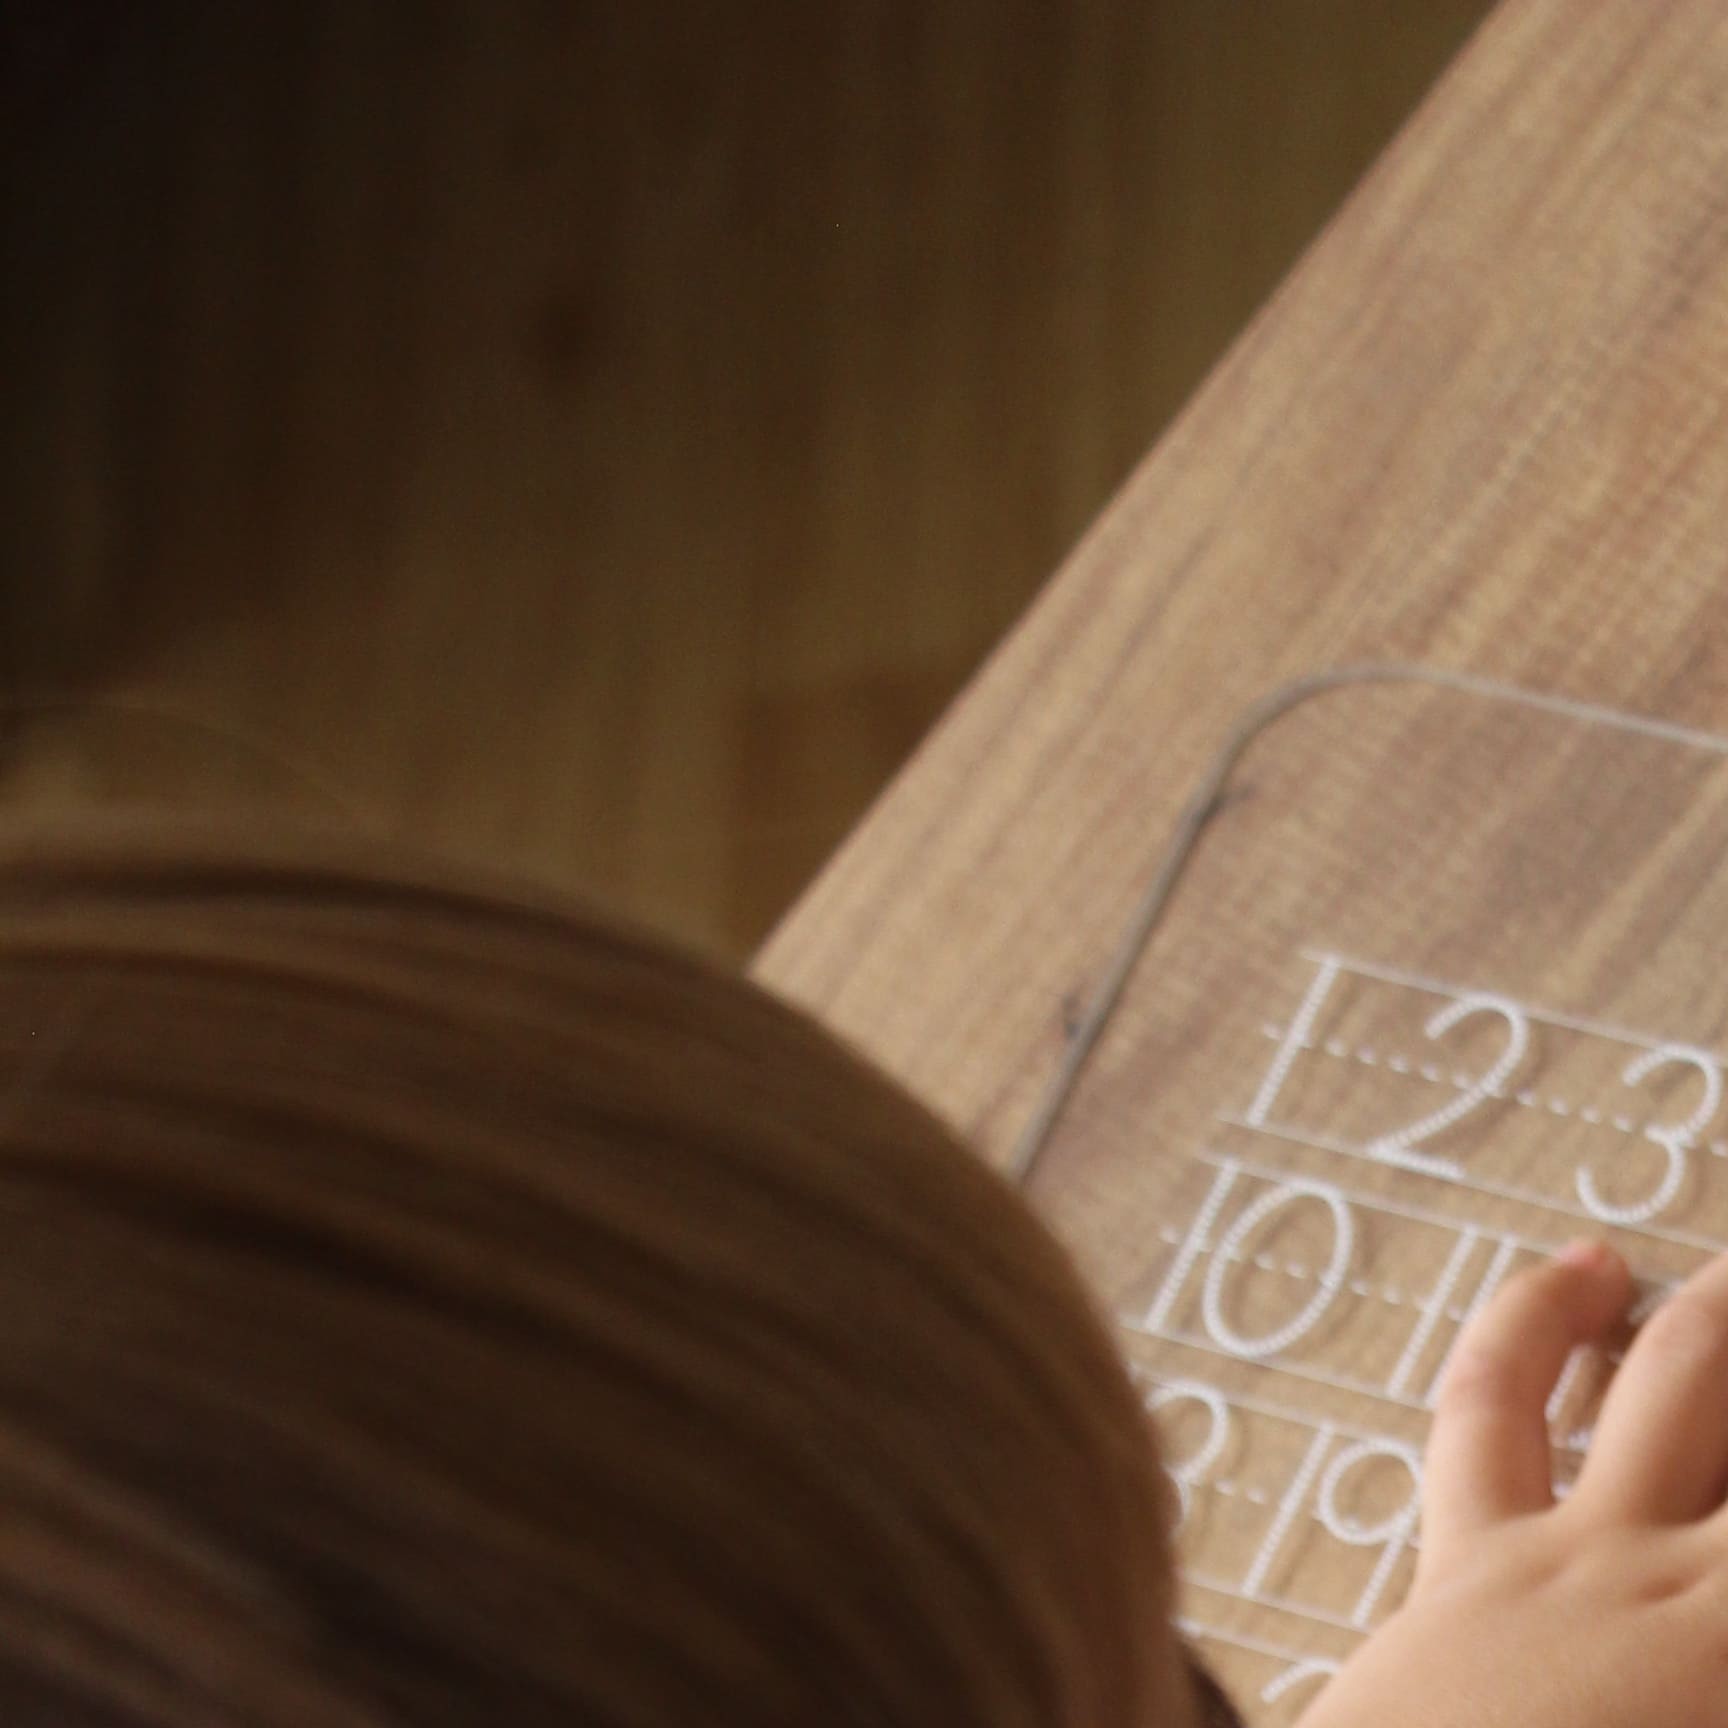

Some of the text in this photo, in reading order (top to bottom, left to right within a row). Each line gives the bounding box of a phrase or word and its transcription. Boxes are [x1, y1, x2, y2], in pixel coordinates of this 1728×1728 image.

[1245, 954, 1342, 1128] 1
[1365, 996, 1529, 1179] 2
[1574, 1043, 1722, 1224] 3
[1143, 1157, 1356, 1360] 10
[1240, 1419, 1426, 1630] 19
